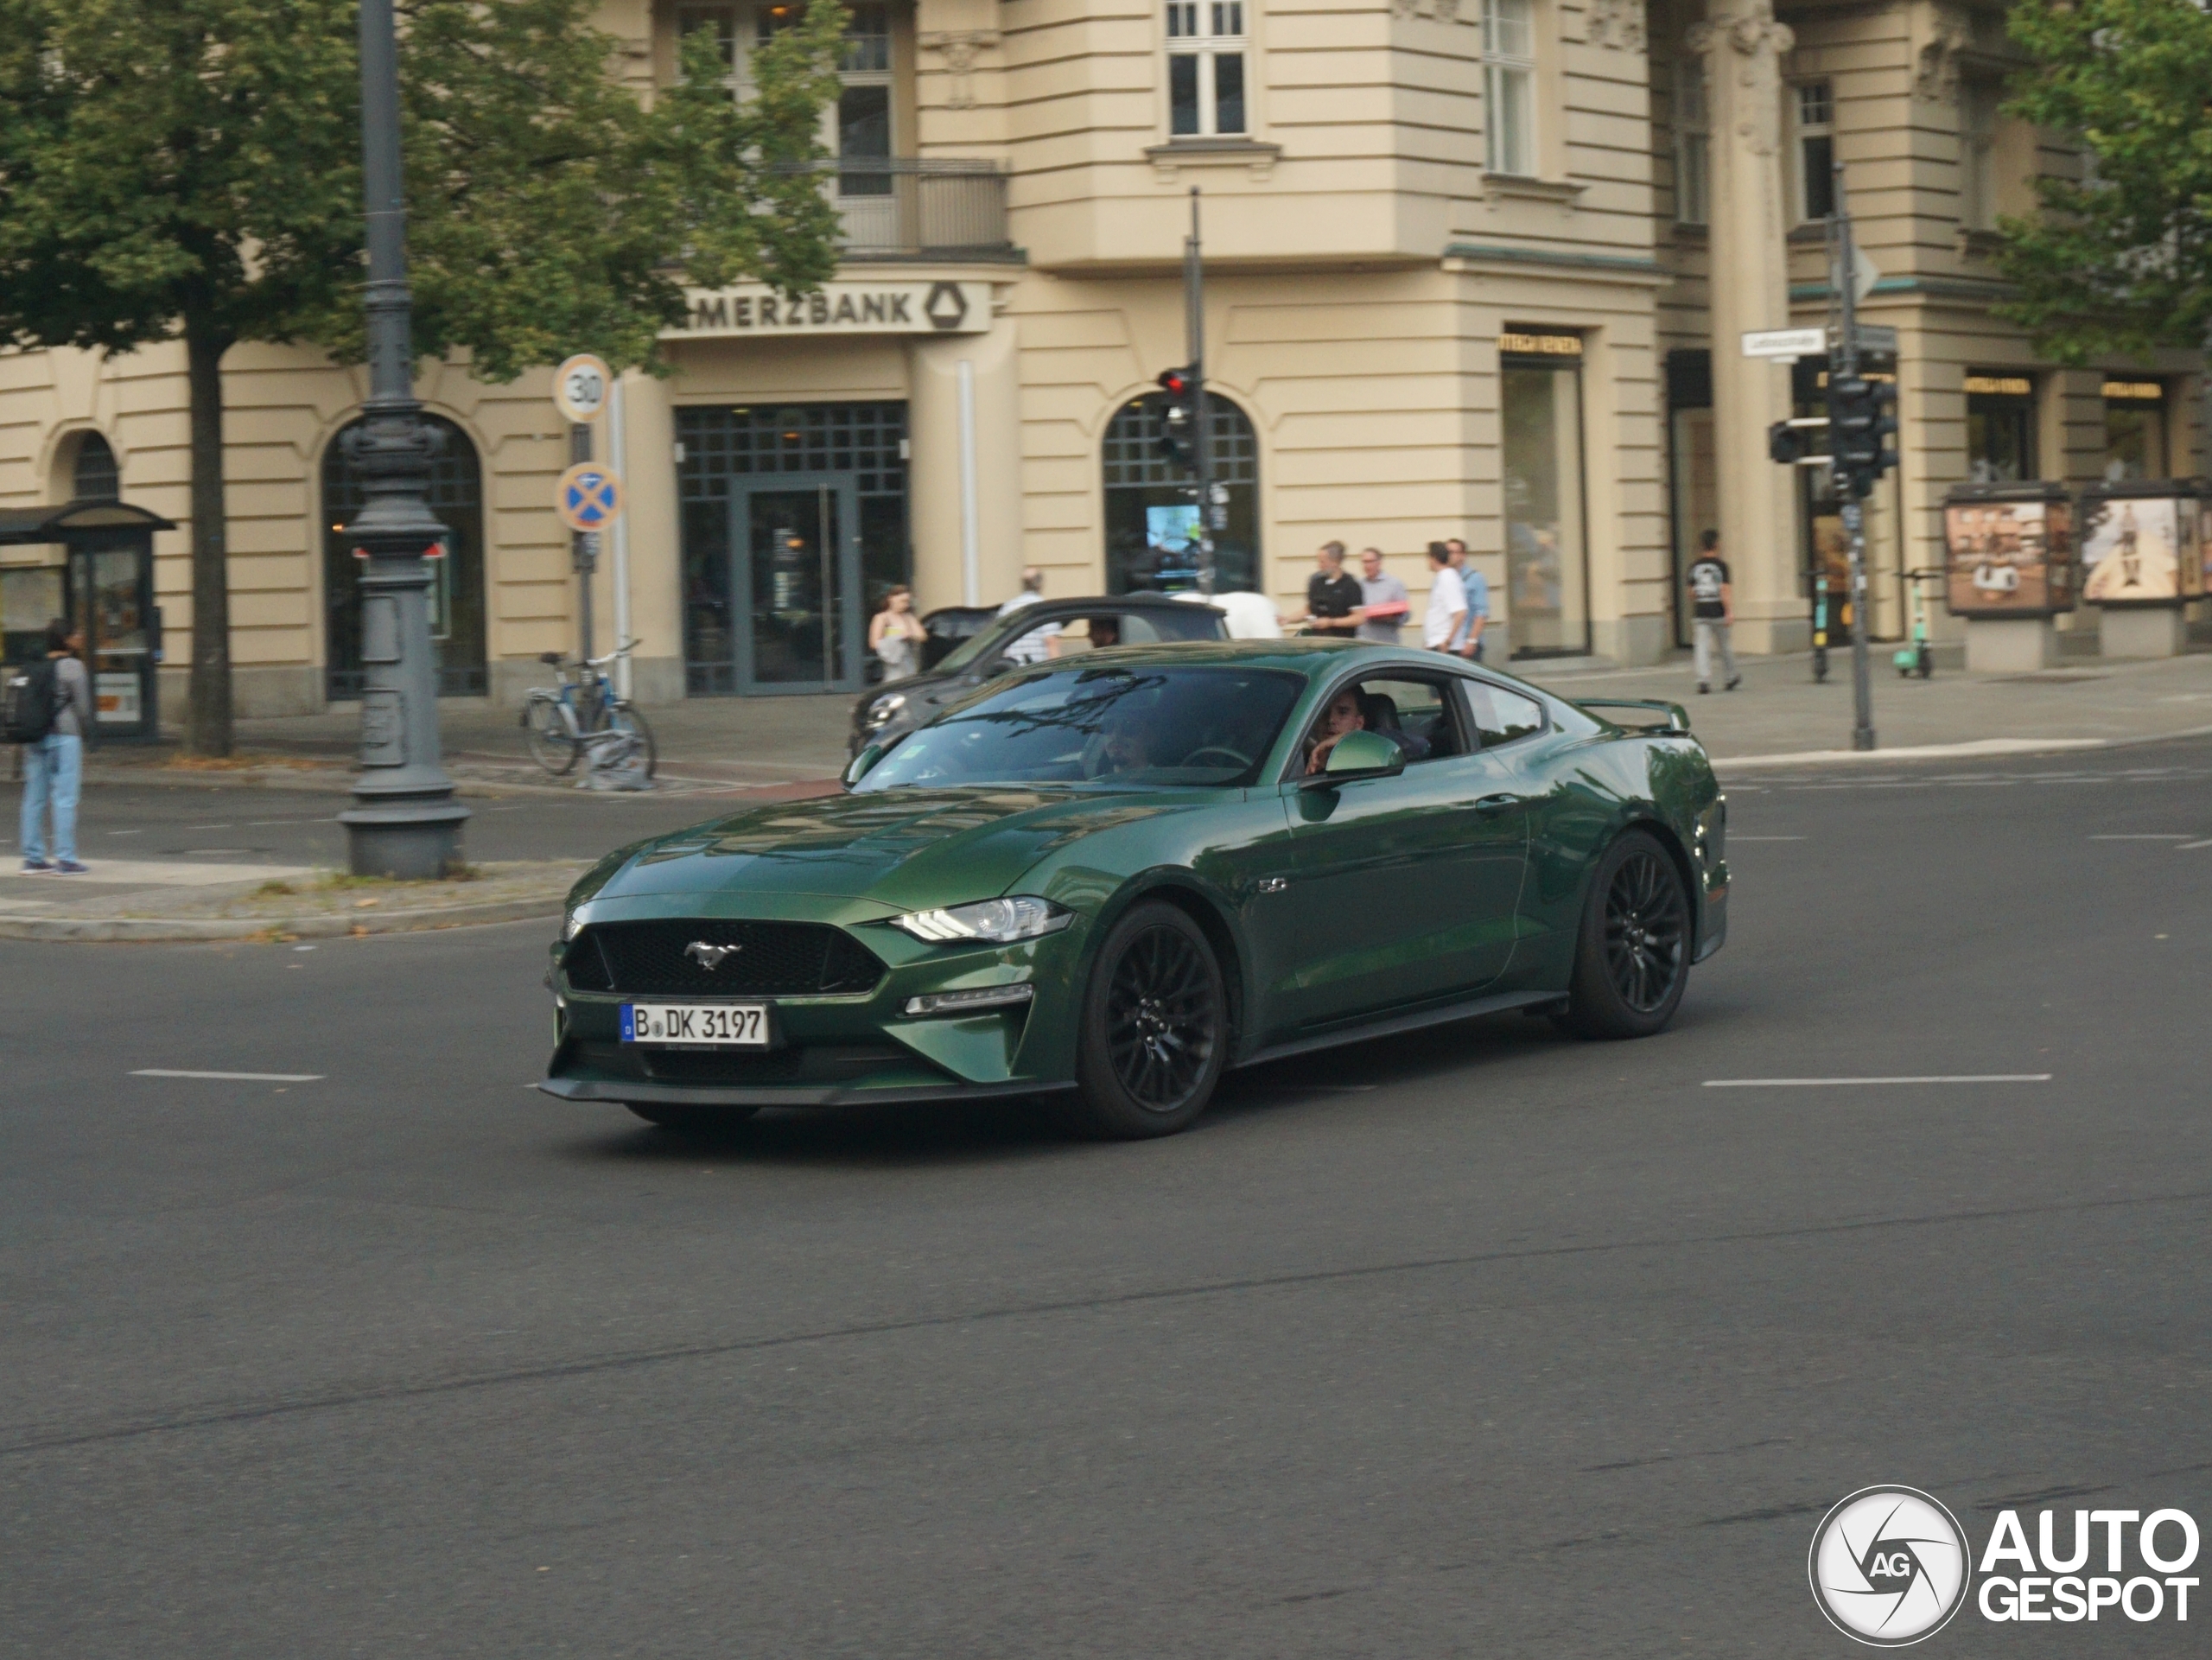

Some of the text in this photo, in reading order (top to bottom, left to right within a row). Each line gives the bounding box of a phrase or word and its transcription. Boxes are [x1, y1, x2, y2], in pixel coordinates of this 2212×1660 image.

[569, 373, 602, 404] 30
[634, 1008, 760, 1039] B DK 3197
